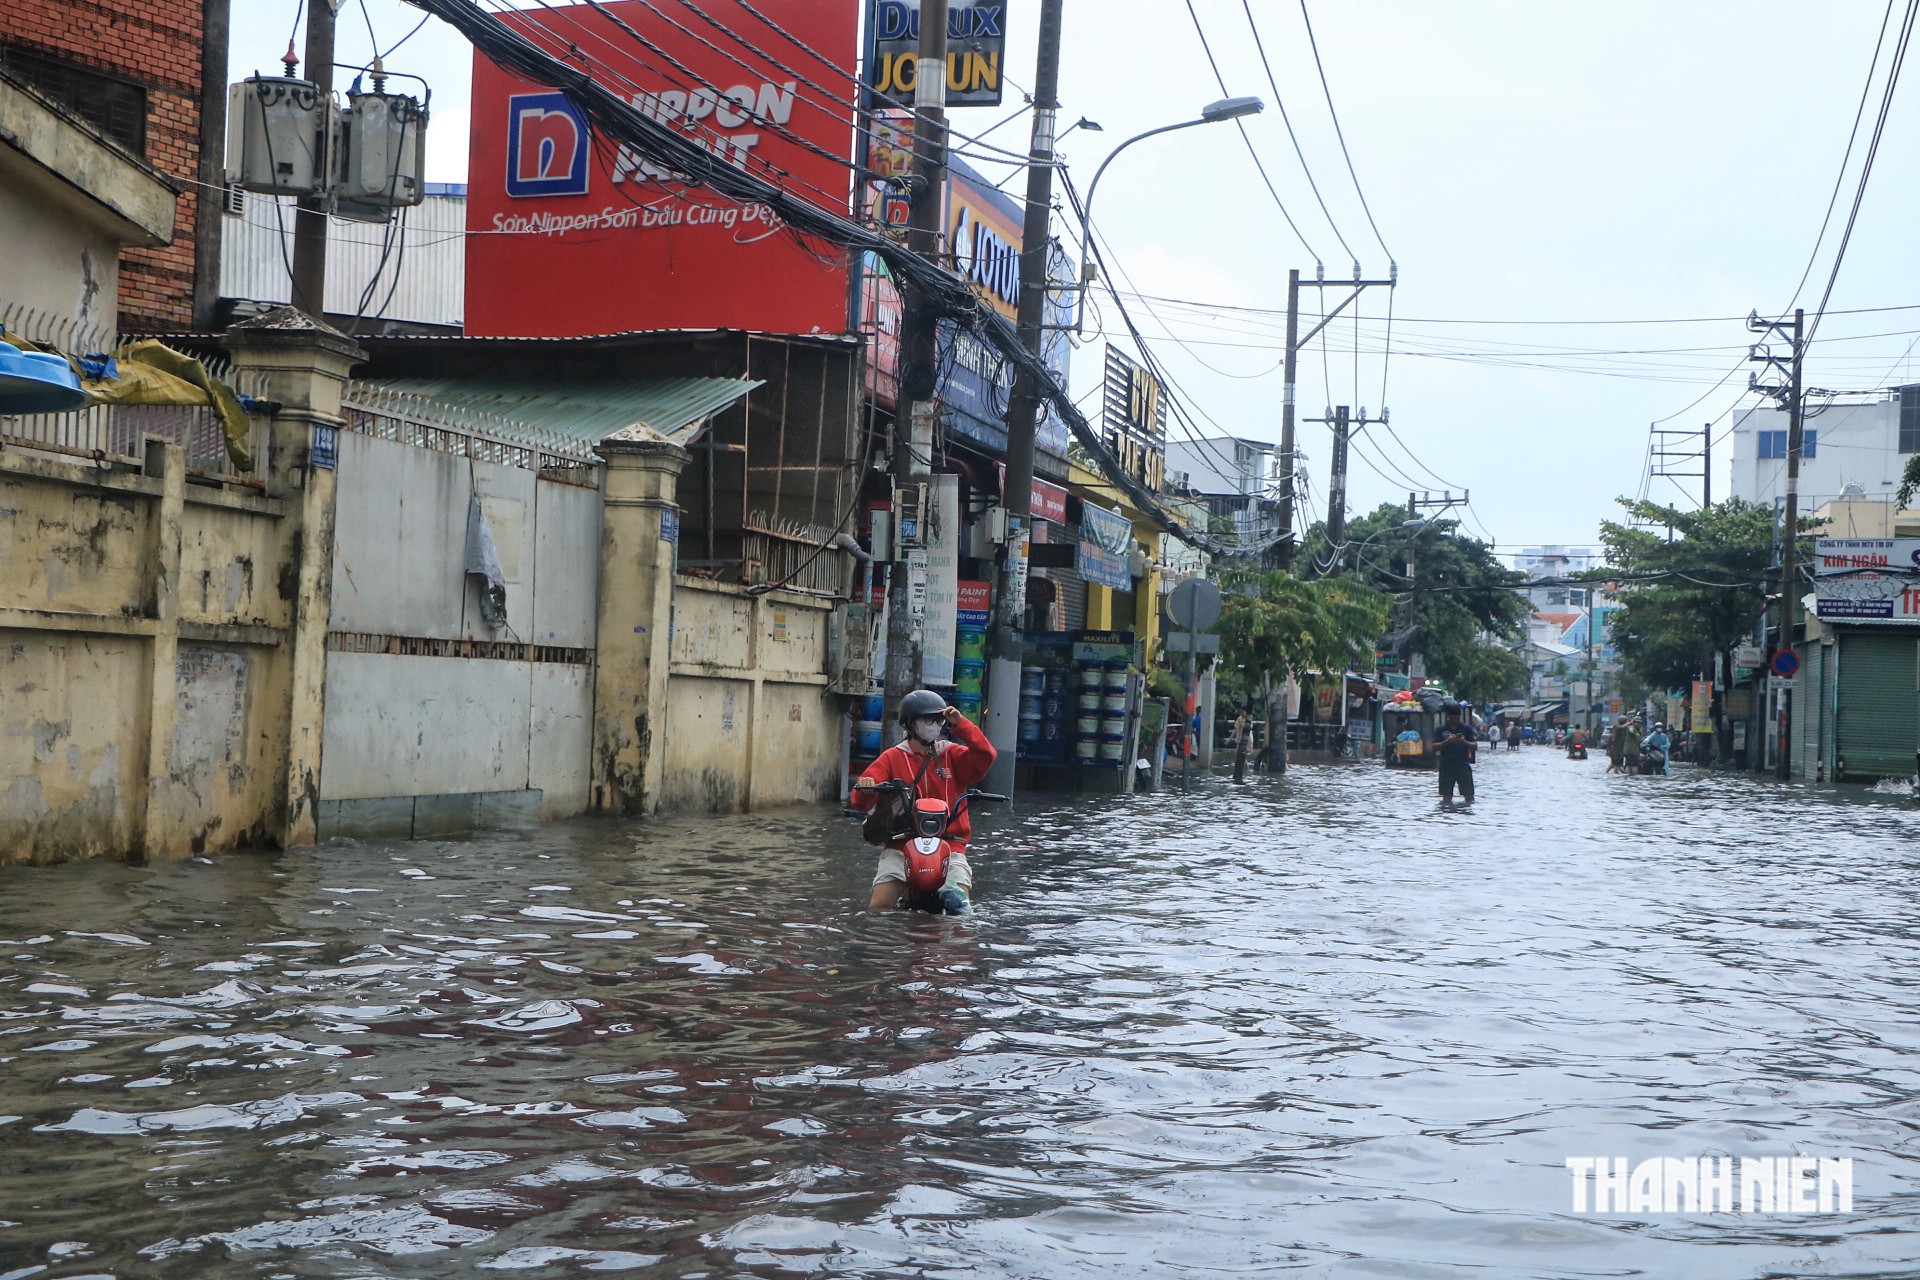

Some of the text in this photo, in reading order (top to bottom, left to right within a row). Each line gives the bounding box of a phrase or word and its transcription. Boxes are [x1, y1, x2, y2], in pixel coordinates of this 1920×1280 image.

[877, 0, 1001, 40] Dux
[875, 52, 998, 92] JOUN
[530, 211, 600, 236] Nippon
[1823, 552, 1888, 568] KIM NGÂN
[961, 588, 987, 597] PAINT
